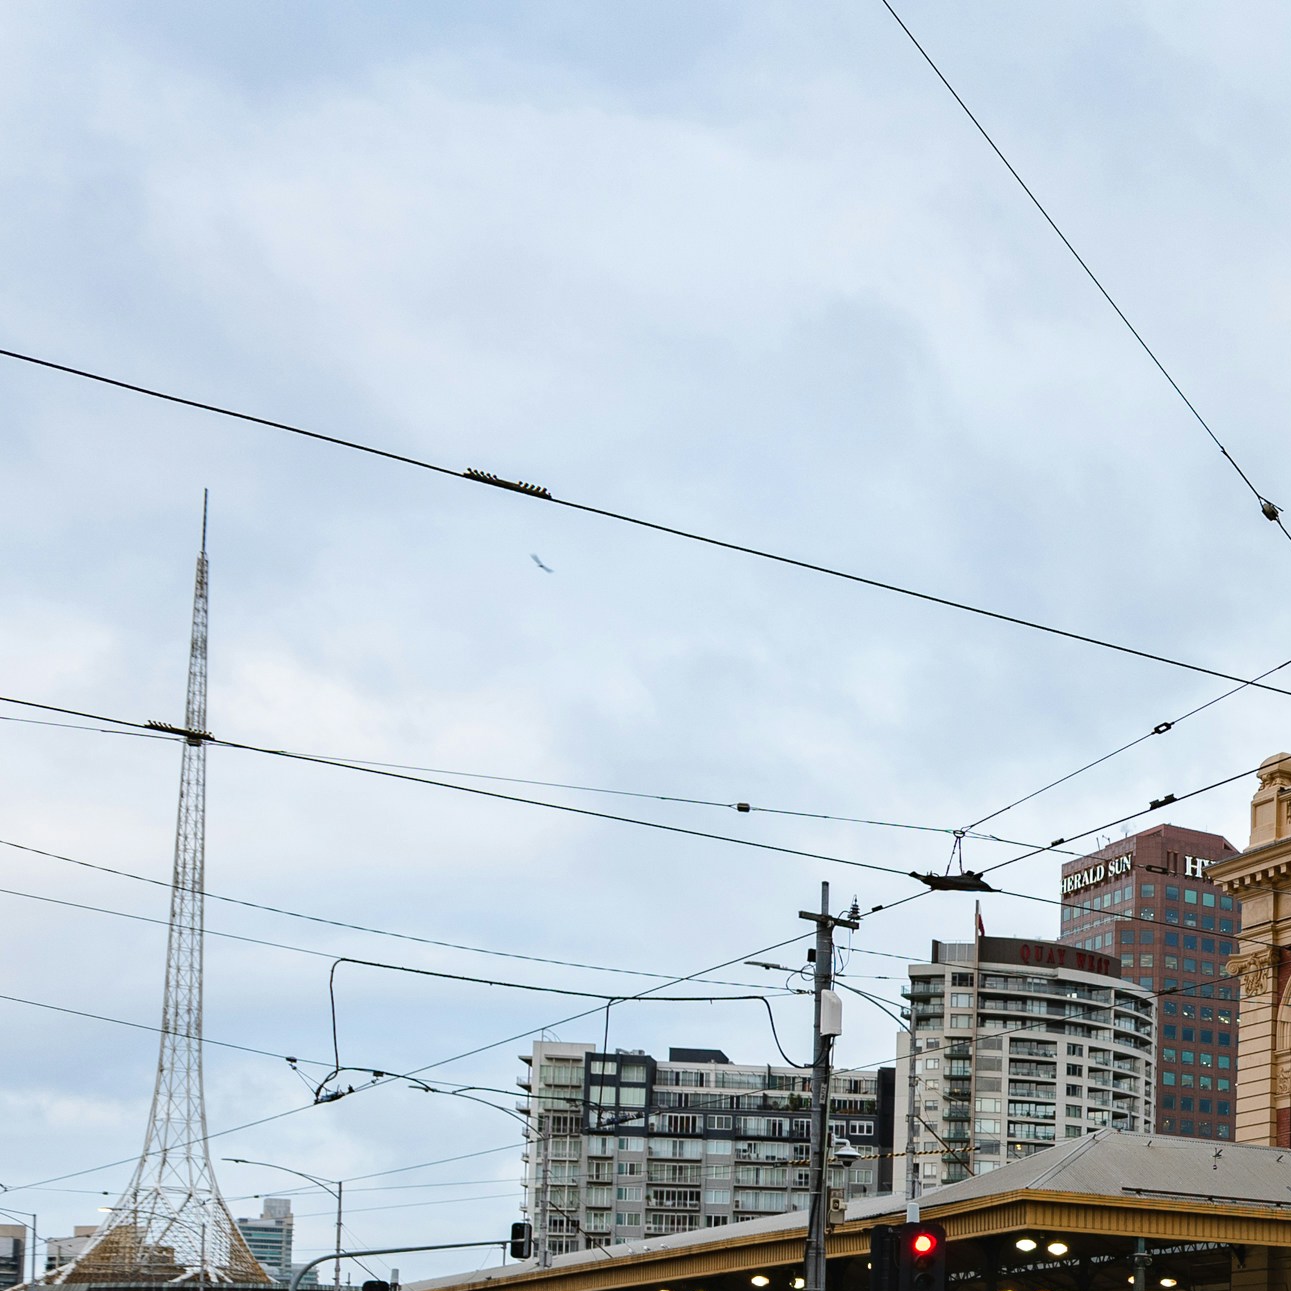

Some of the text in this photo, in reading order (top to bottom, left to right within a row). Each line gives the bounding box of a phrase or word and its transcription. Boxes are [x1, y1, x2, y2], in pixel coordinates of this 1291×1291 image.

[1061, 854, 1132, 895] HERALD SUN
[1020, 944, 1110, 976] QUAY WEST
